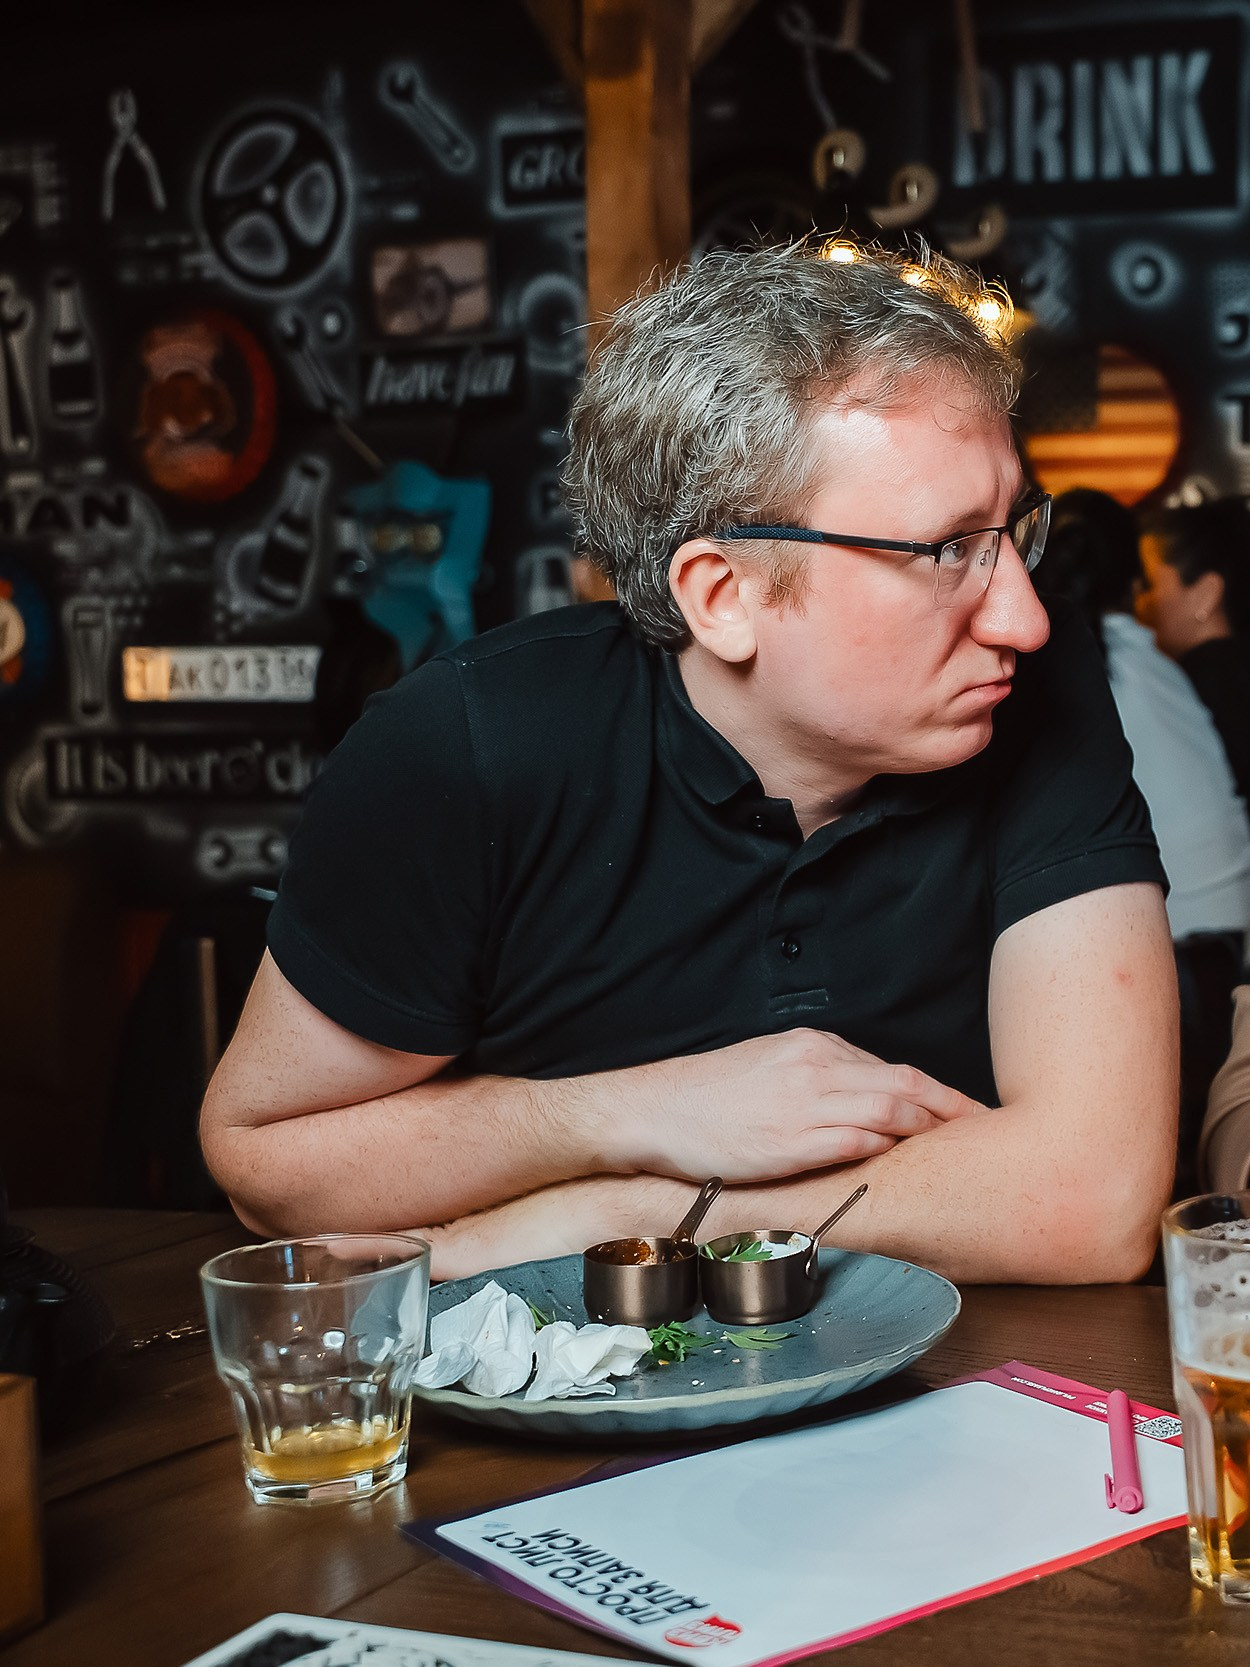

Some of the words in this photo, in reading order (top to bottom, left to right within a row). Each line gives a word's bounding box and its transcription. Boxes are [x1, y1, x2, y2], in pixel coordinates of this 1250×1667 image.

[953, 49, 1214, 188] DRINK
[481, 1530, 564, 1568] ЛИСТ
[530, 1527, 646, 1584] ЗАПИСИ
[548, 1565, 671, 1625] ПРОСТО
[628, 1579, 711, 1615] ДЛЯ
